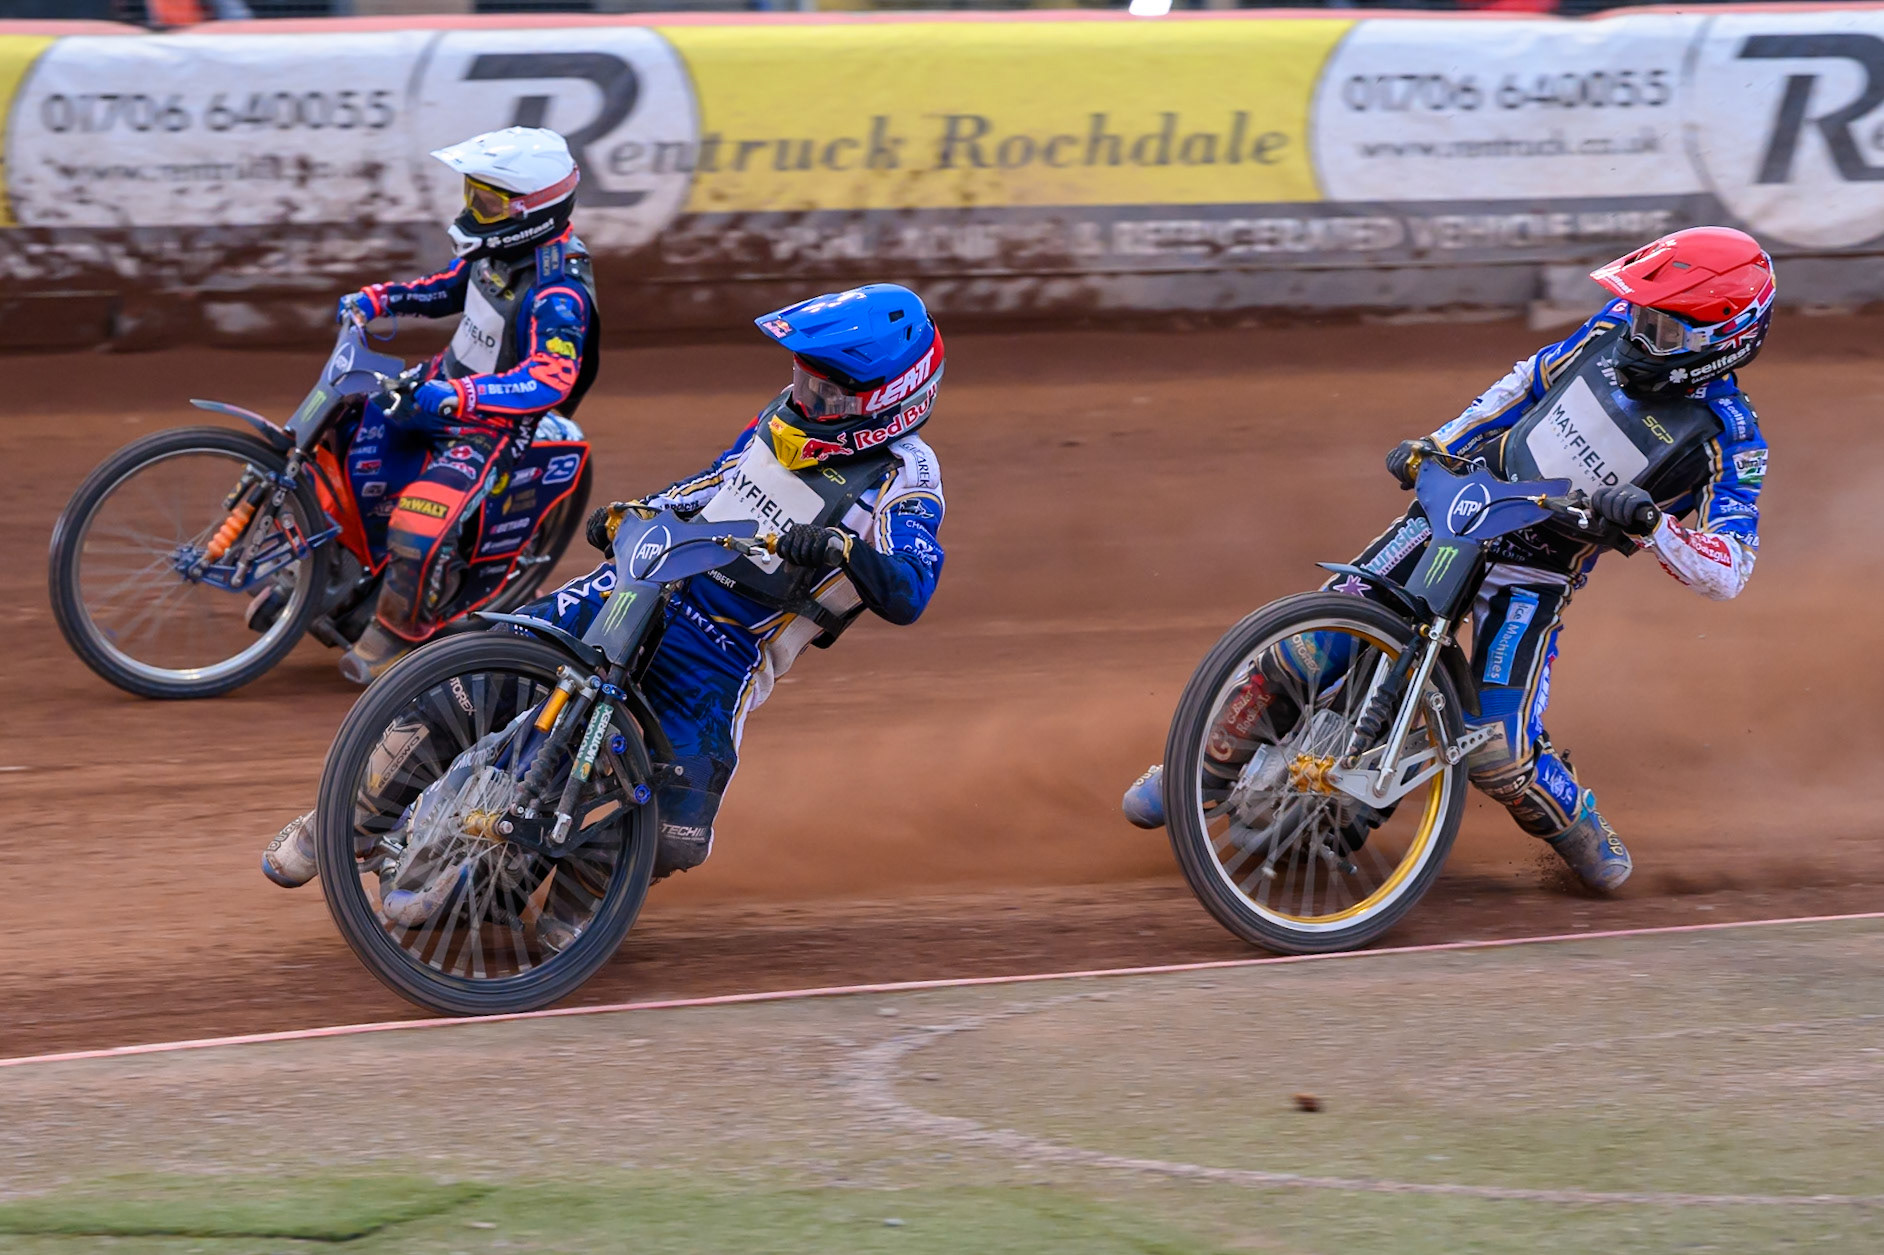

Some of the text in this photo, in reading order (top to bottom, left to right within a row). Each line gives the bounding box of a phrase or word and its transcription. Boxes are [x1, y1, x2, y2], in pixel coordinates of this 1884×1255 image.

[1342, 70, 1671, 111] 01706 640055
[41, 91, 396, 133] 01706 640055
[937, 112, 1289, 170] Rochdale
[866, 347, 935, 411] LEATT
[1690, 343, 1751, 378] cellfast
[855, 382, 937, 450] Red Bull
[1641, 415, 1674, 444] SGP
[1553, 404, 1618, 486] MAYFIELD
[731, 469, 796, 534] AYFIELD
[1453, 500, 1483, 517] ATPI
[636, 543, 664, 560] ATPI
[707, 570, 737, 589] MBERT
[1513, 604, 1529, 621] Ice
[1292, 634, 1321, 674] OTOREX
[1490, 624, 1521, 680] Machines
[450, 678, 477, 716] TOREX
[584, 708, 614, 765] MOTOREX
